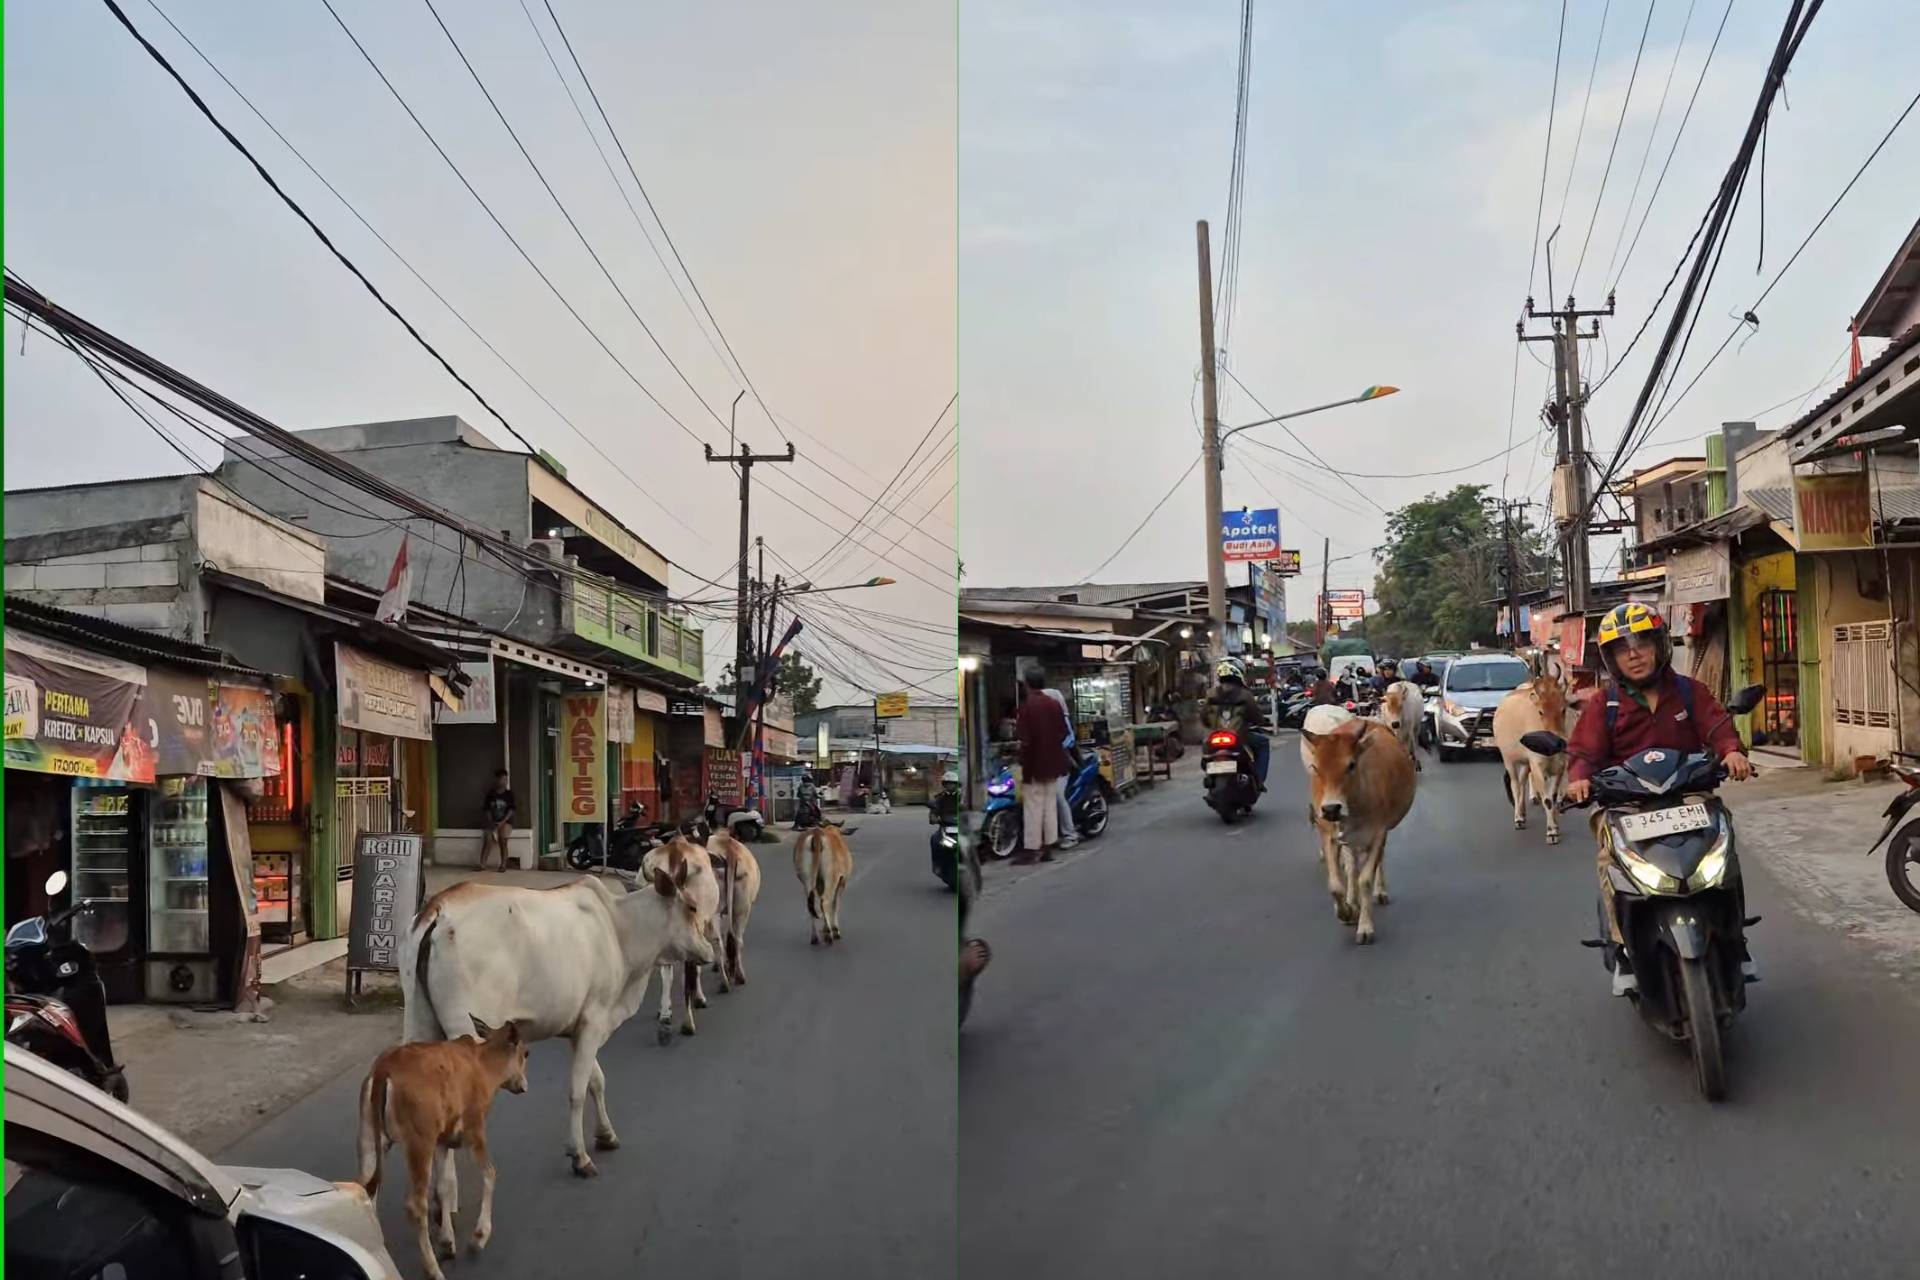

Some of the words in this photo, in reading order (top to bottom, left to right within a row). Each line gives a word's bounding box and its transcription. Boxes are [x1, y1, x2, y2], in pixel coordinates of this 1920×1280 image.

[1222, 524, 1277, 538] Apotek
[44, 690, 89, 718] PERTAMA
[44, 719, 77, 741] KRETEK
[84, 725, 116, 746] KAPSUL
[567, 697, 600, 816] WARTEG
[709, 750, 738, 762] JUAL
[363, 838, 411, 856] Refill
[366, 858, 398, 965] PARFUME
